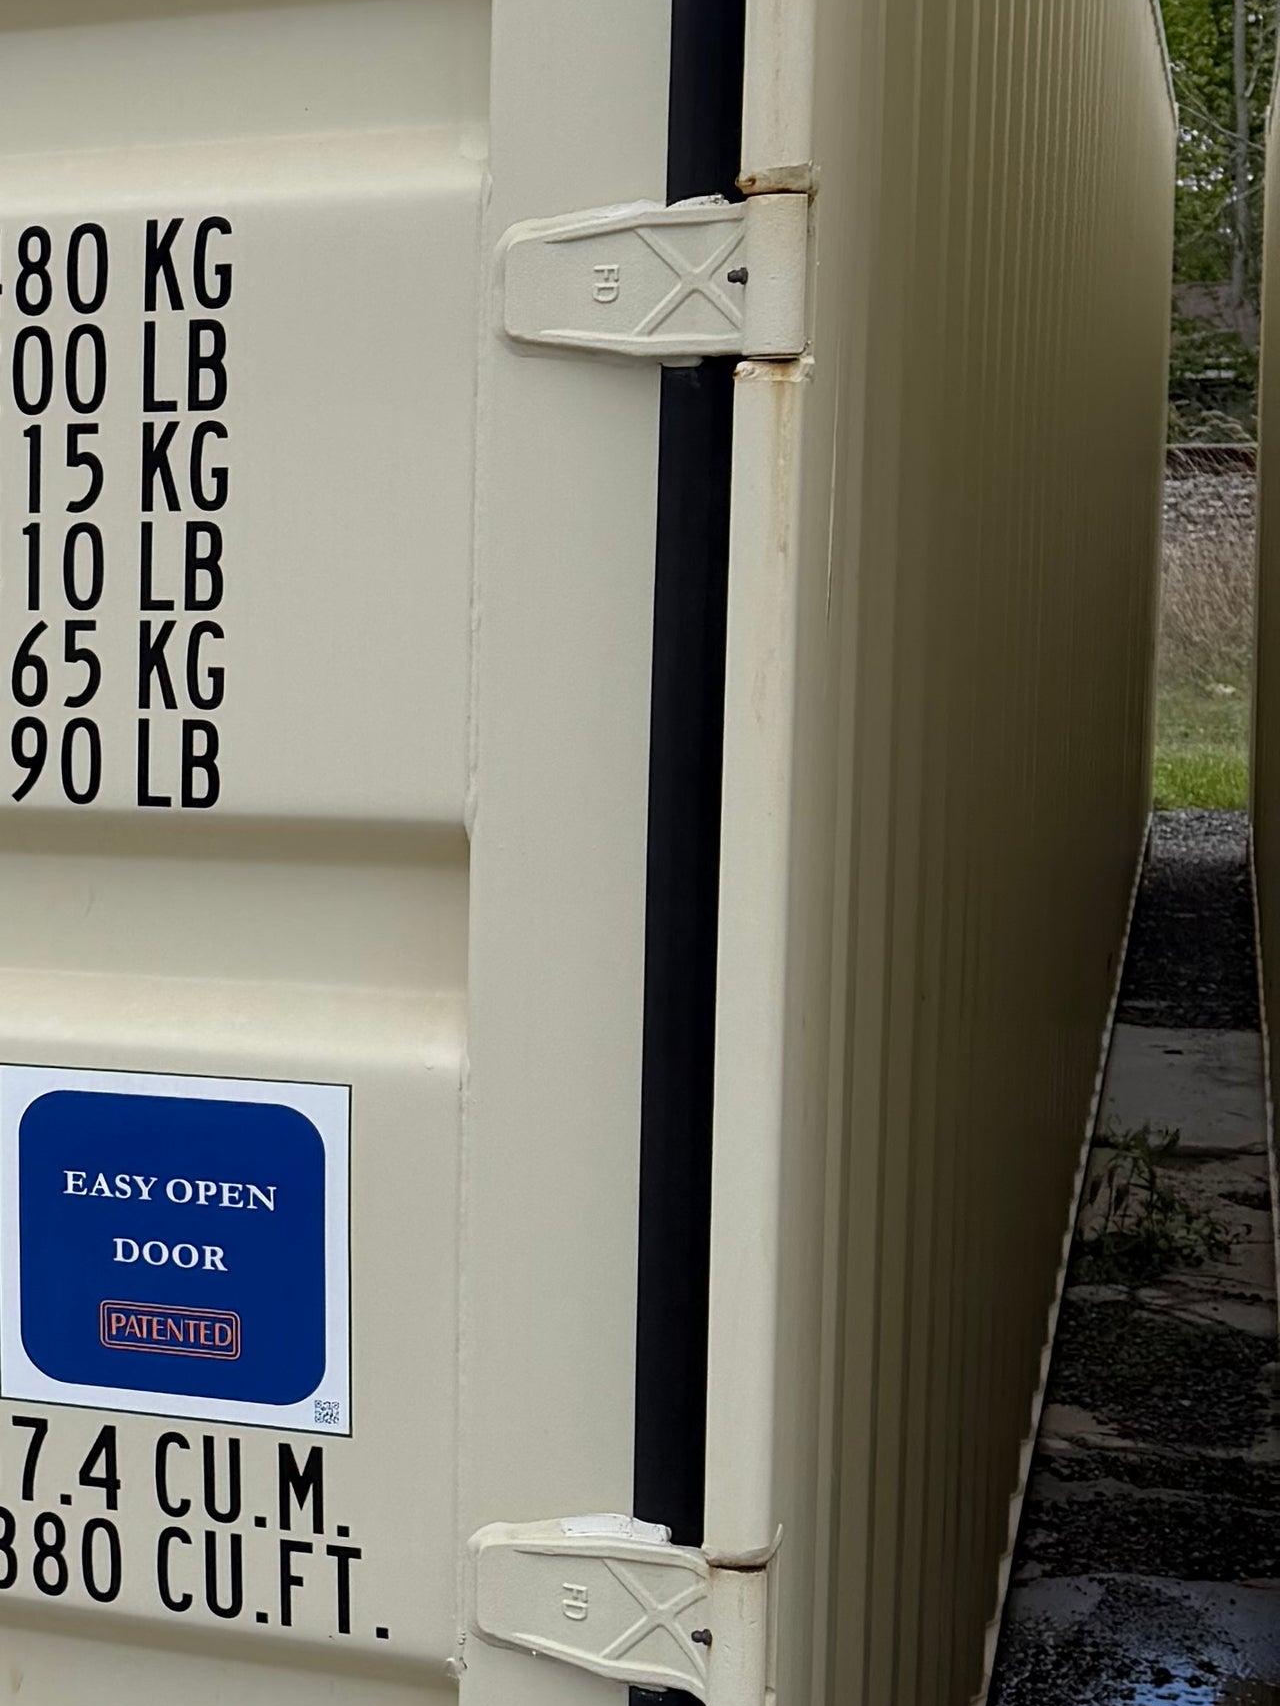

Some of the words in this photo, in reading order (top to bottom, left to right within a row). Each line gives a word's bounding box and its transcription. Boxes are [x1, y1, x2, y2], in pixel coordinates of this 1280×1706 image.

[145, 217, 232, 311] KG
[143, 319, 227, 412] LB
[142, 421, 228, 512] KG
[140, 521, 223, 611] LB
[139, 621, 224, 710] KG
[138, 719, 219, 808] LB
[63, 1170, 160, 1201] EASY
[166, 1178, 277, 1212] OPEN
[112, 1238, 228, 1271] DOOR
[110, 1313, 233, 1346] PATENTED
